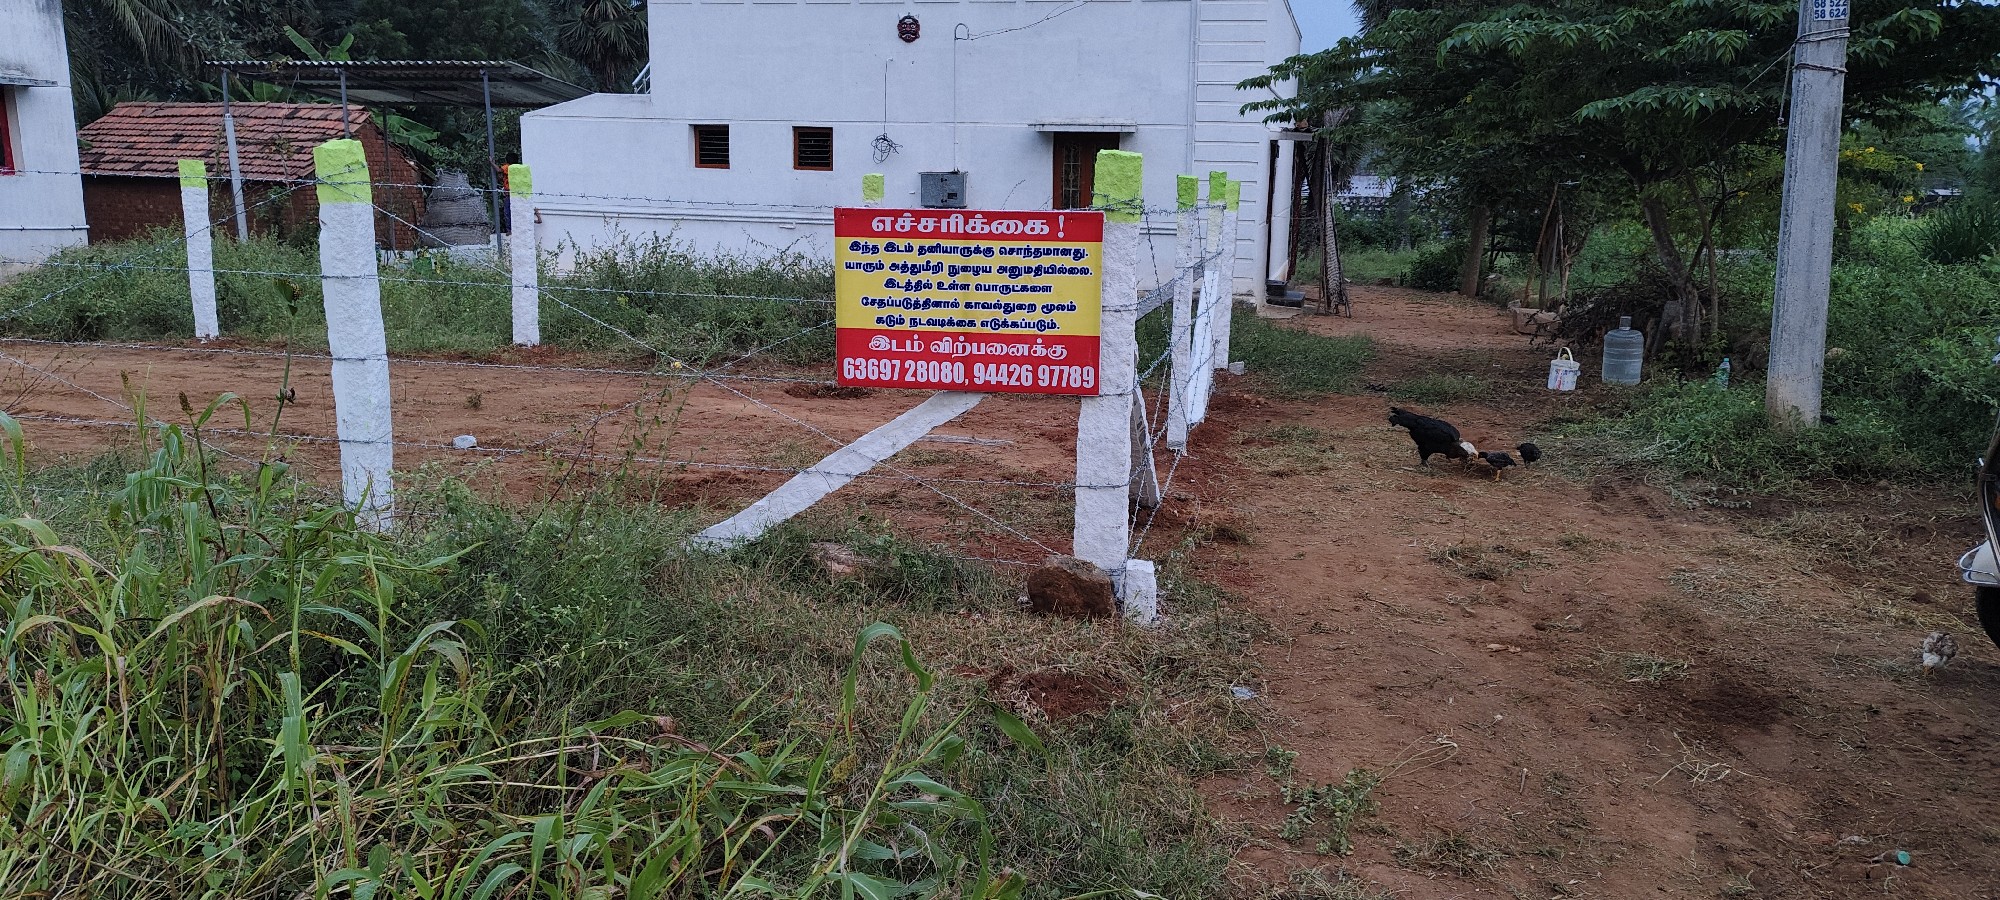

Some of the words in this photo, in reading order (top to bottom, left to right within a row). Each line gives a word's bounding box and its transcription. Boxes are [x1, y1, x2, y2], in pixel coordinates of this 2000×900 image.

[1814, 0, 1826, 8] 68
[1814, 9, 1826, 19] 58
[1829, 8, 1847, 18] 624
[871, 212, 1050, 235] எச்சரிக்கை
[849, 240, 880, 254] இந்த
[884, 241, 914, 253] இடம்
[917, 242, 995, 257] தனியாருக்கு
[998, 245, 1089, 261] சொந்தமானது.
[845, 259, 885, 272] யாரும்
[889, 260, 944, 275] அத்துமீறி
[947, 263, 992, 277] நுழைய
[996, 263, 1093, 279] அனுமதியில்லை.
[884, 278, 933, 292] இடத்தில்
[936, 280, 970, 291] உள்ள
[974, 283, 1053, 295] பொருட்களை
[861, 296, 960, 310] சேதப்படுத்தினால்
[963, 299, 1037, 315] காவல்துறை
[1041, 300, 1077, 314] மூலம்
[875, 314, 905, 327] கடும்
[909, 317, 977, 328] நடவடிக்கை
[980, 318, 1060, 332] எடுக்கப்படும்.
[868, 333, 925, 352] இடம்
[930, 335, 1068, 360] விற்பனைக்கு
[842, 357, 901, 381] 63697
[904, 359, 969, 386] 28080,
[973, 362, 1033, 387] 94426
[1037, 364, 1095, 389] 97789
